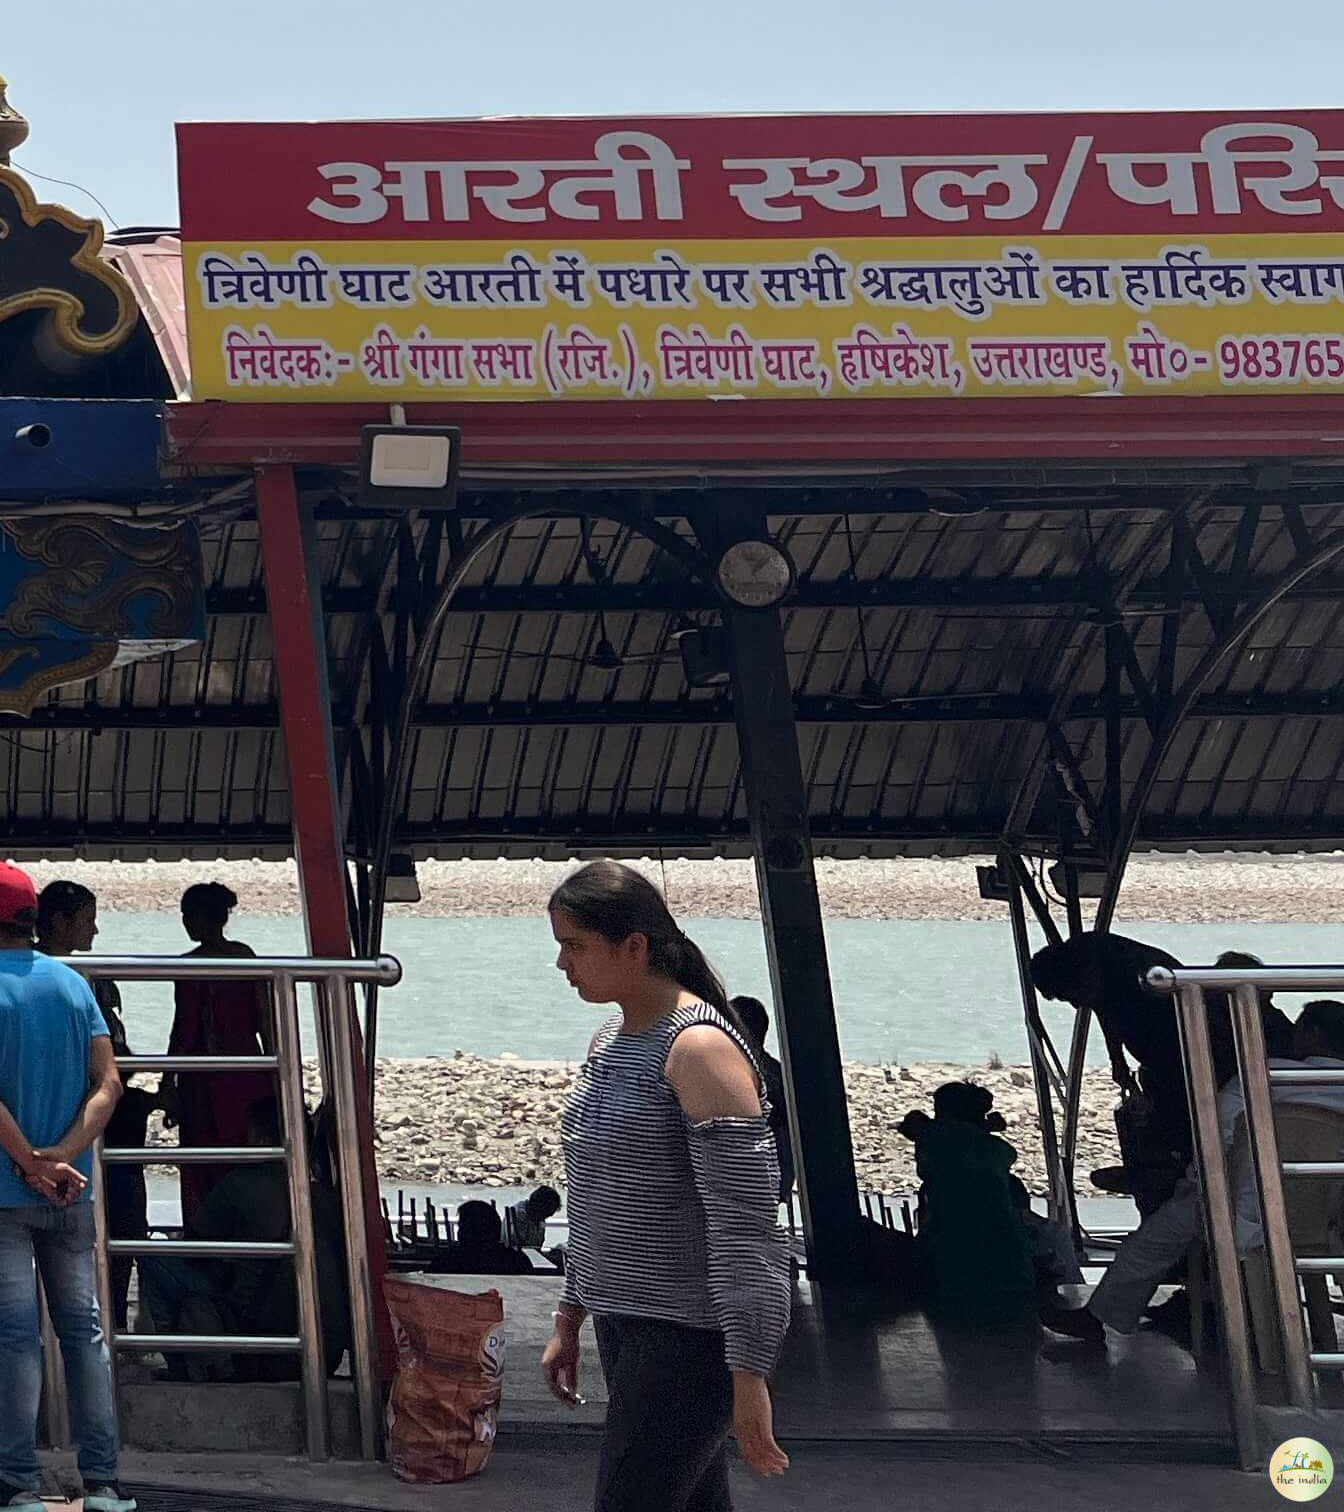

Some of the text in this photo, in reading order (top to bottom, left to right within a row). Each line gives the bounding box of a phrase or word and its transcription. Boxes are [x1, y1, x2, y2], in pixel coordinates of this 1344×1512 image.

[307, 131, 691, 223] आरती
[203, 256, 327, 302] त्रिवेणी
[339, 269, 410, 302] घाट
[424, 255, 541, 302] आरती
[553, 256, 585, 302] में
[598, 255, 690, 302] पधारे
[703, 269, 750, 303] पर
[760, 254, 846, 302] सभी
[861, 252, 1040, 315] श्रद्धालुओं
[1053, 265, 1109, 299] का
[1121, 251, 1247, 306] हार्दिक
[363, 329, 399, 379] श्री
[409, 331, 464, 379] गंगा
[472, 344, 532, 379] सभा
[544, 329, 650, 391] (रजि.),
[660, 330, 753, 380] त्रिवेणी
[762, 344, 828, 389] घाट,
[971, 343, 1119, 388] उत्तराखण्ड,
[1220, 339, 1344, 378] 983765
